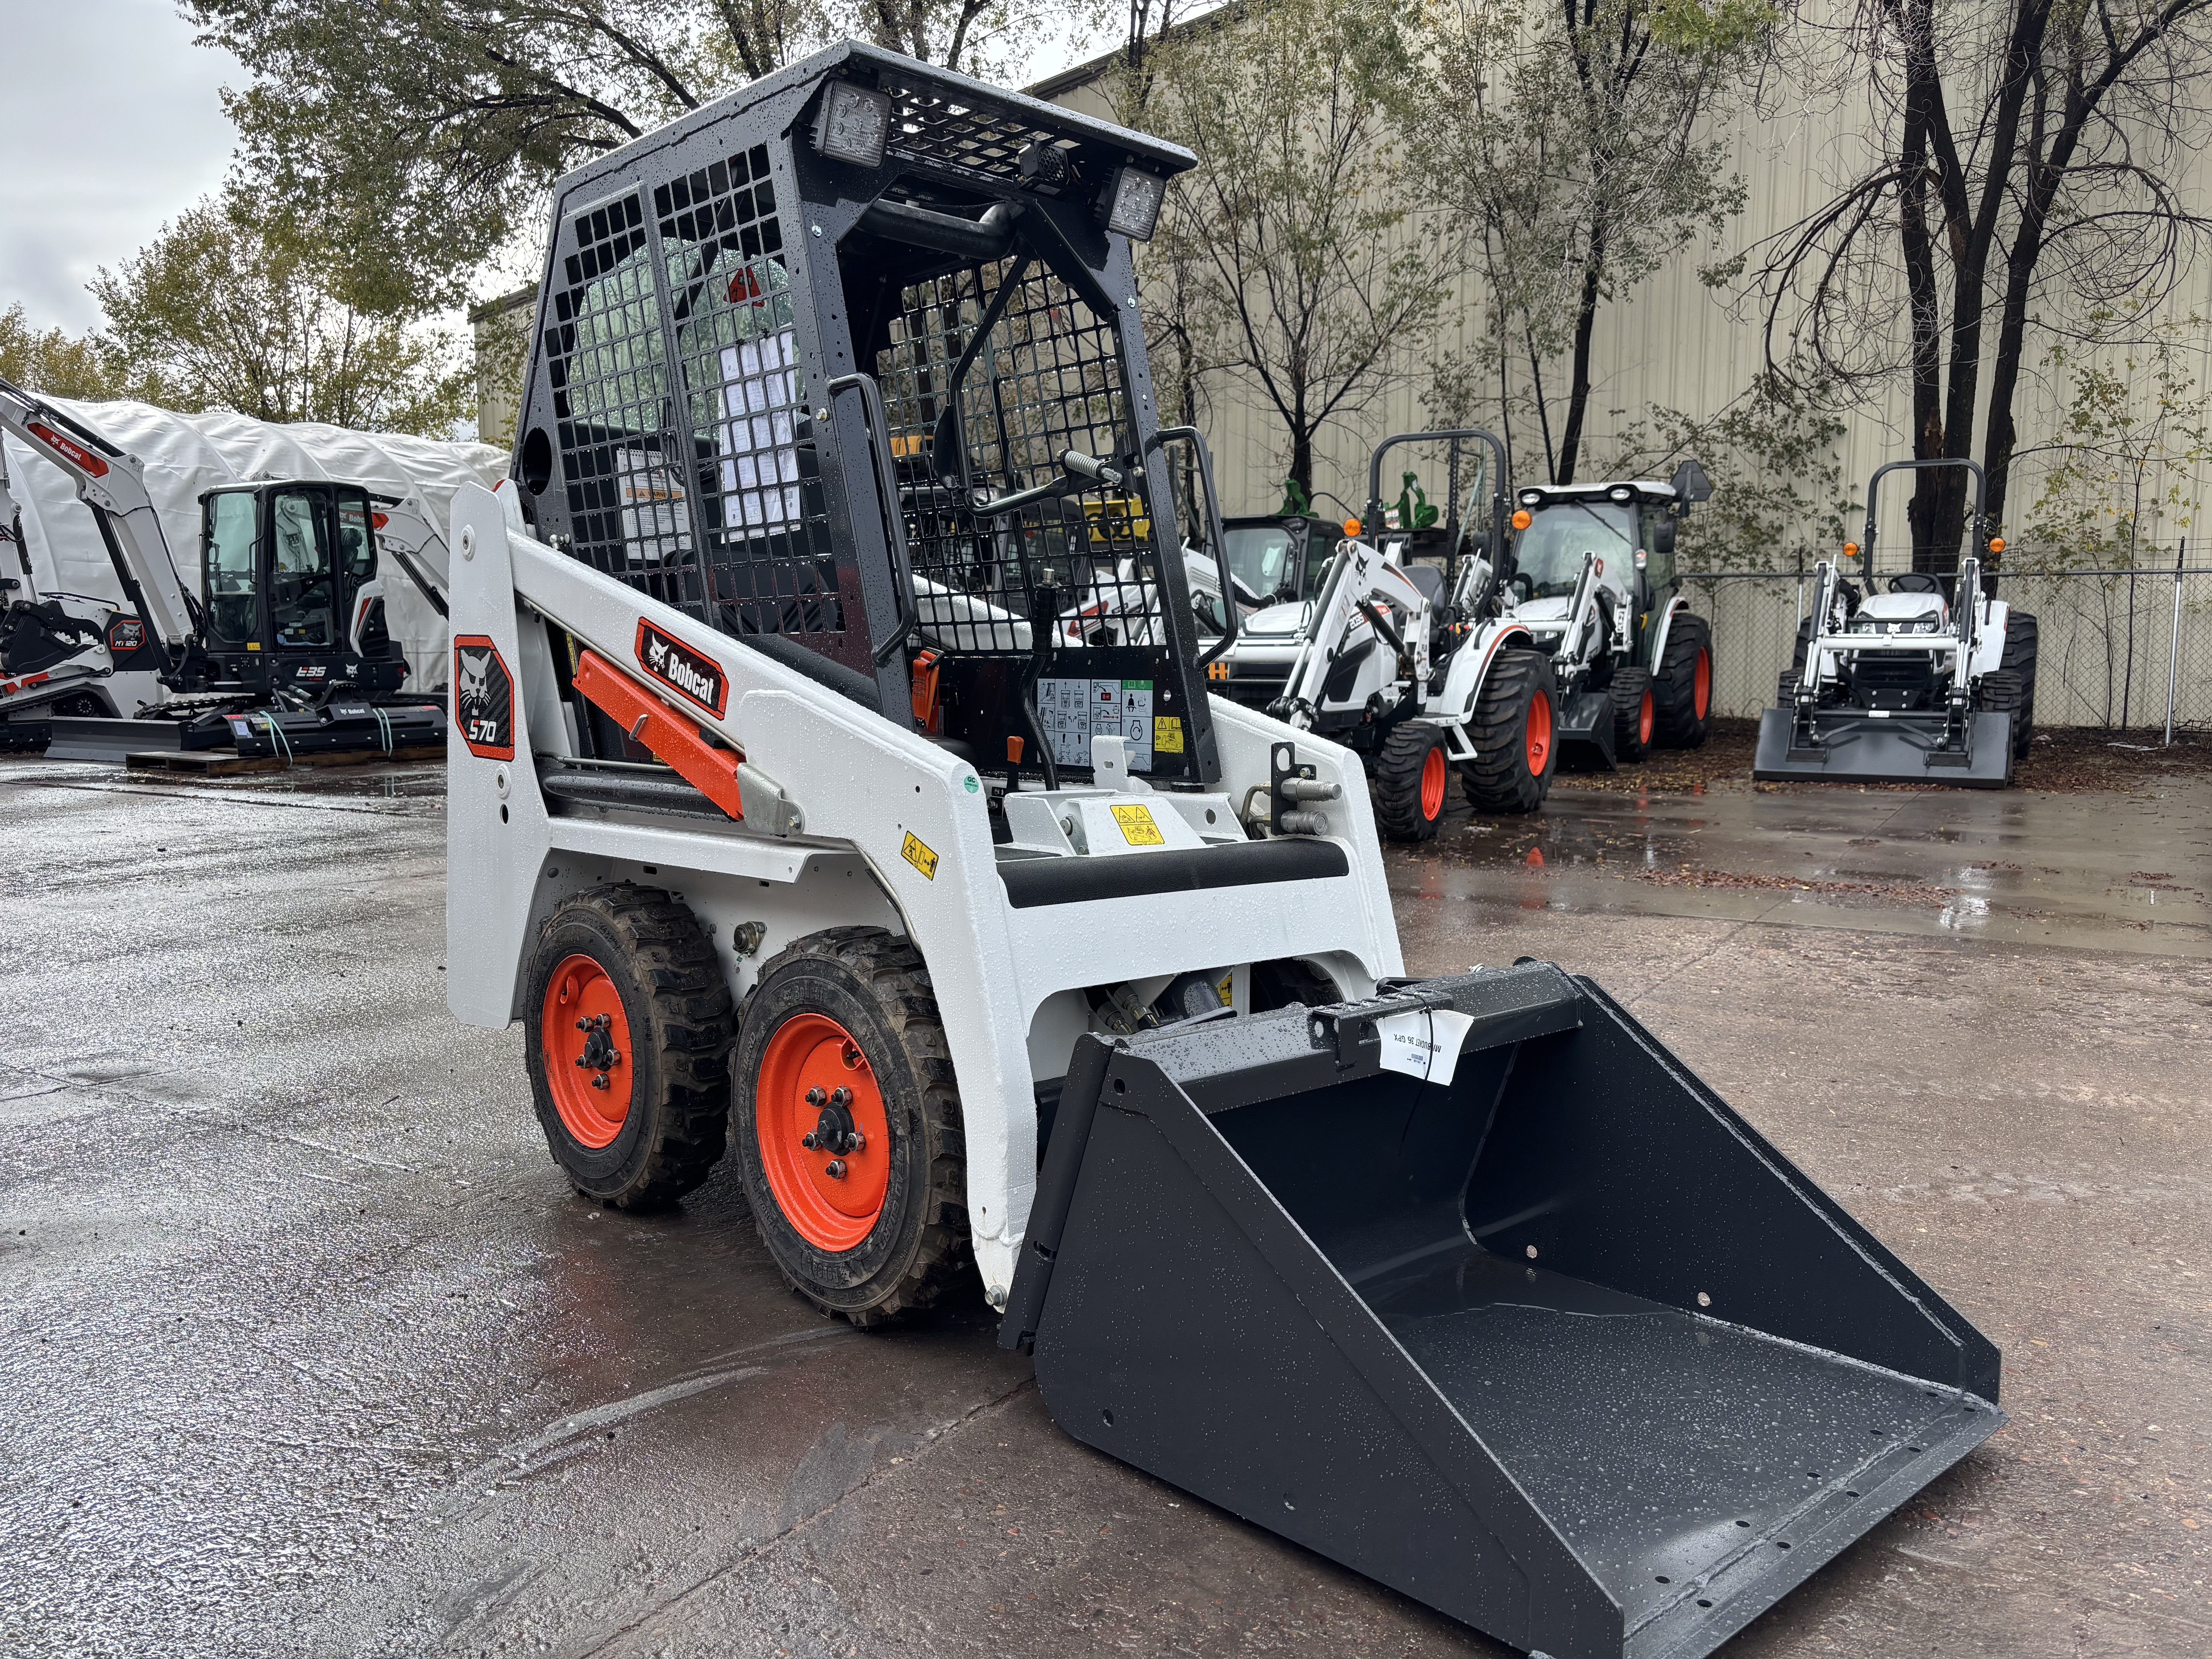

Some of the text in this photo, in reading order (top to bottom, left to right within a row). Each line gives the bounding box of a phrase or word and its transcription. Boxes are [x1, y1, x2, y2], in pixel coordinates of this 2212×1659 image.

[60, 442, 81, 461] Bobcat
[349, 514, 365, 524] Bobc
[1349, 613, 1364, 629] 2035
[296, 666, 326, 677] E35
[668, 652, 714, 704] Bobcat
[469, 720, 496, 742] S70
[1394, 1034, 1406, 1043] GPX
[1408, 1037, 1414, 1045] 36
[1415, 1038, 1432, 1050] BUCKET
[895, 1148, 906, 1197] BEAD
[879, 1200, 900, 1249] GUARD
